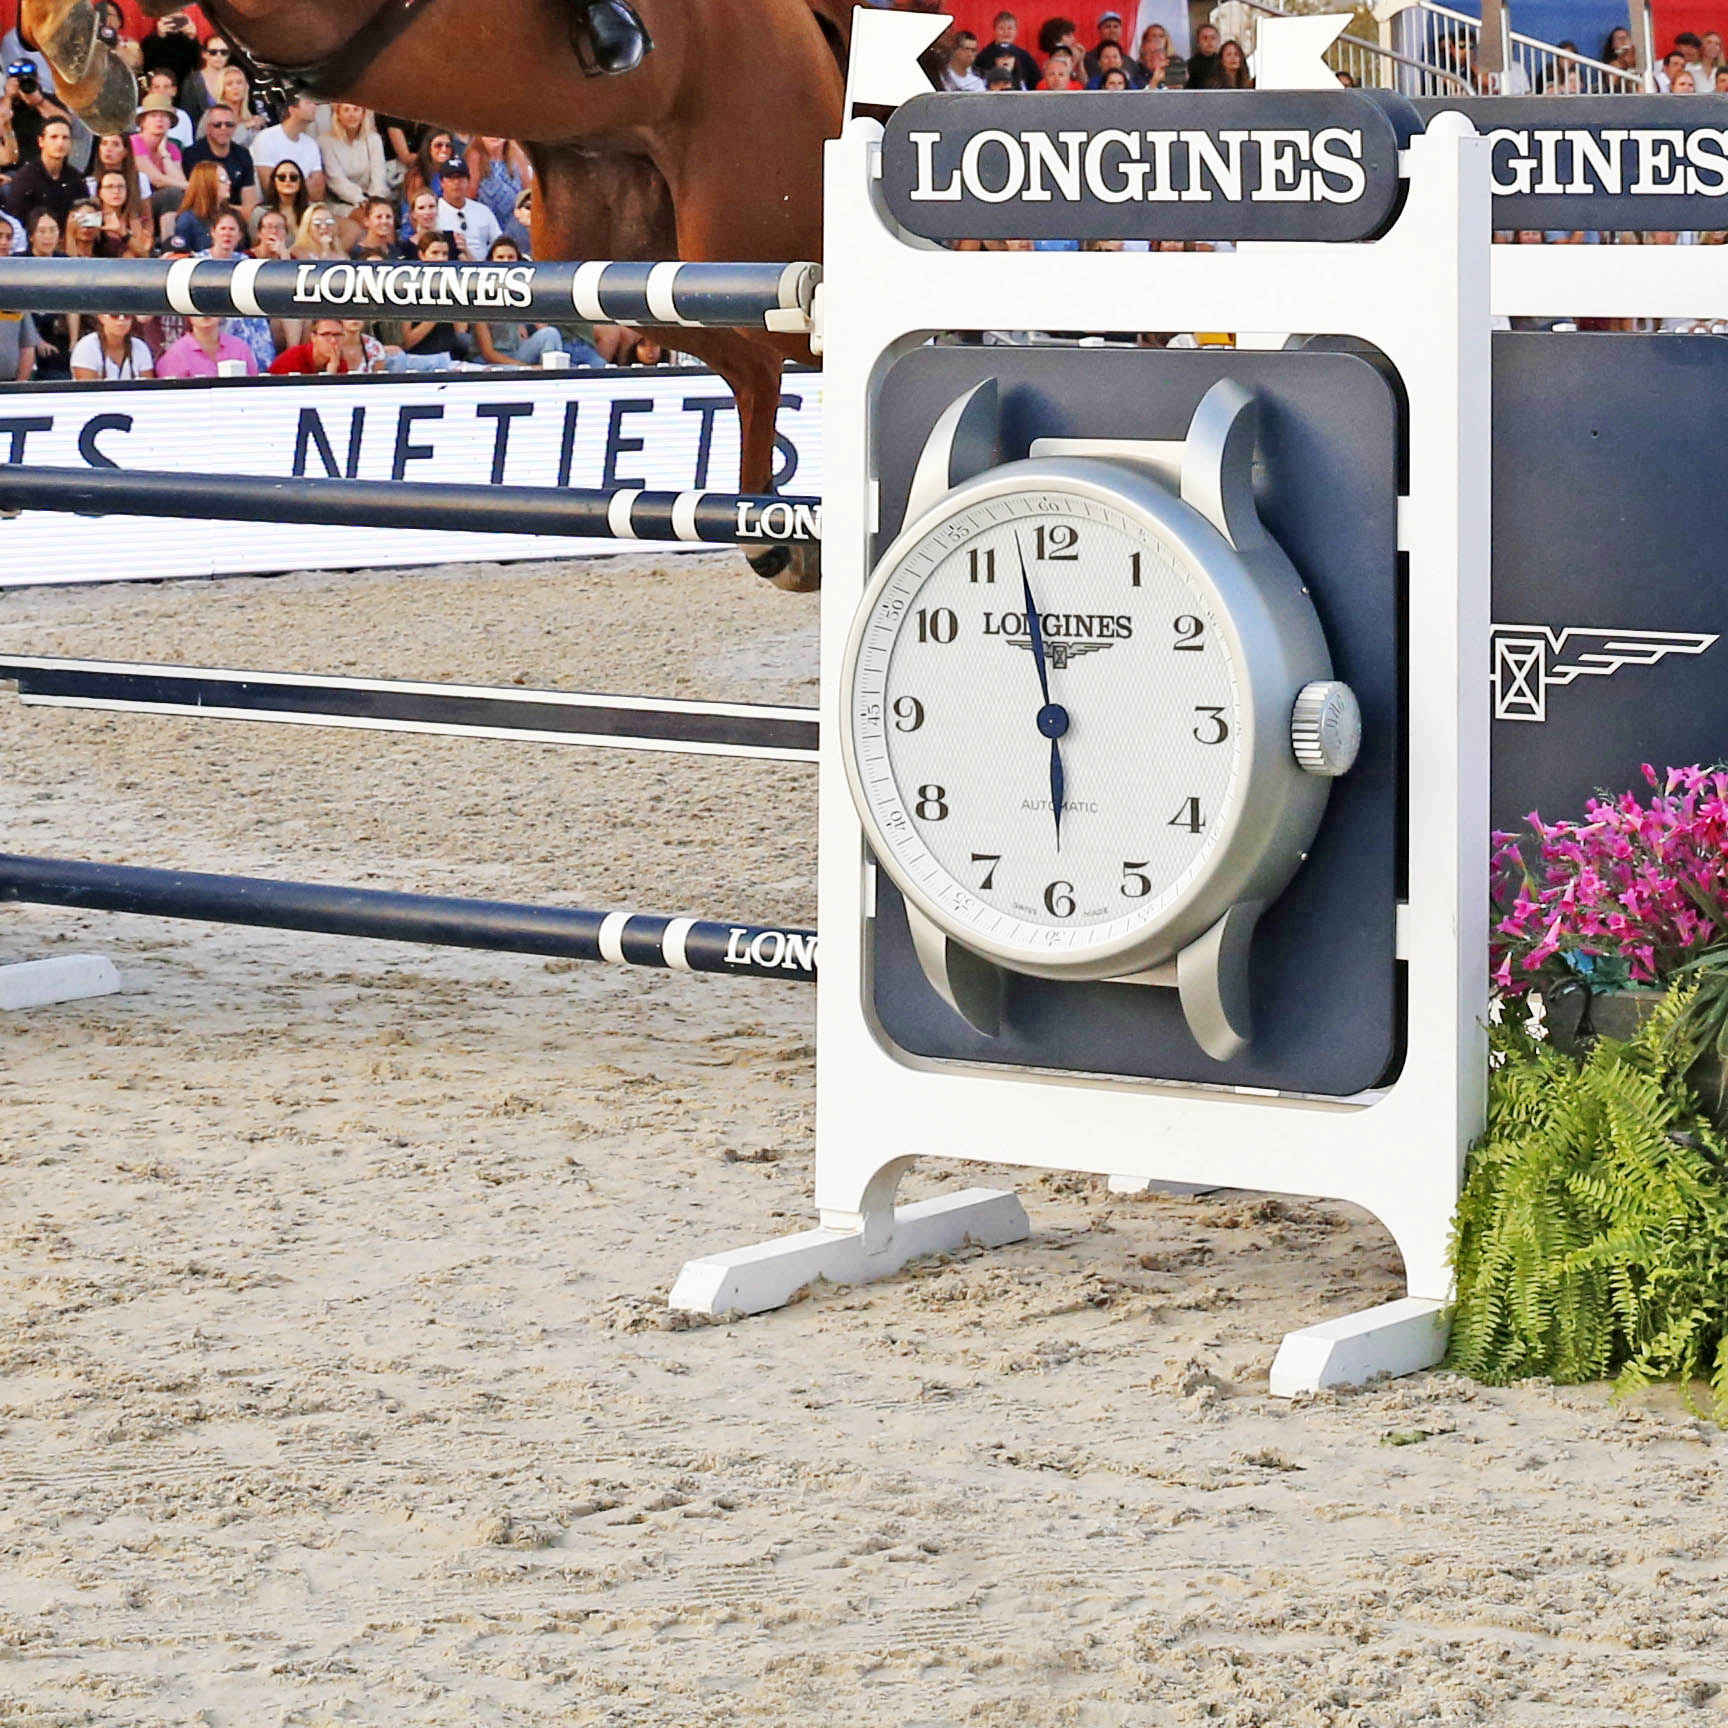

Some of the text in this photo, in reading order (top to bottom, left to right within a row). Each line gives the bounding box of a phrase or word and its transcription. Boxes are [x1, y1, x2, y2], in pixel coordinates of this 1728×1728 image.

[909, 127, 1366, 204] LONGINES
[293, 263, 536, 308] LONGINES
[1034, 525, 1079, 561] 12
[967, 548, 995, 584] 11
[1129, 552, 1142, 588] 1
[916, 607, 959, 644] 10
[1173, 614, 1204, 652] 2
[893, 696, 924, 732] 9
[1193, 706, 1229, 745] 3
[916, 784, 949, 822] 8
[1168, 796, 1206, 834] 4
[972, 852, 1003, 890] 7
[1120, 859, 1152, 898] 5
[1044, 880, 1076, 918] 6
